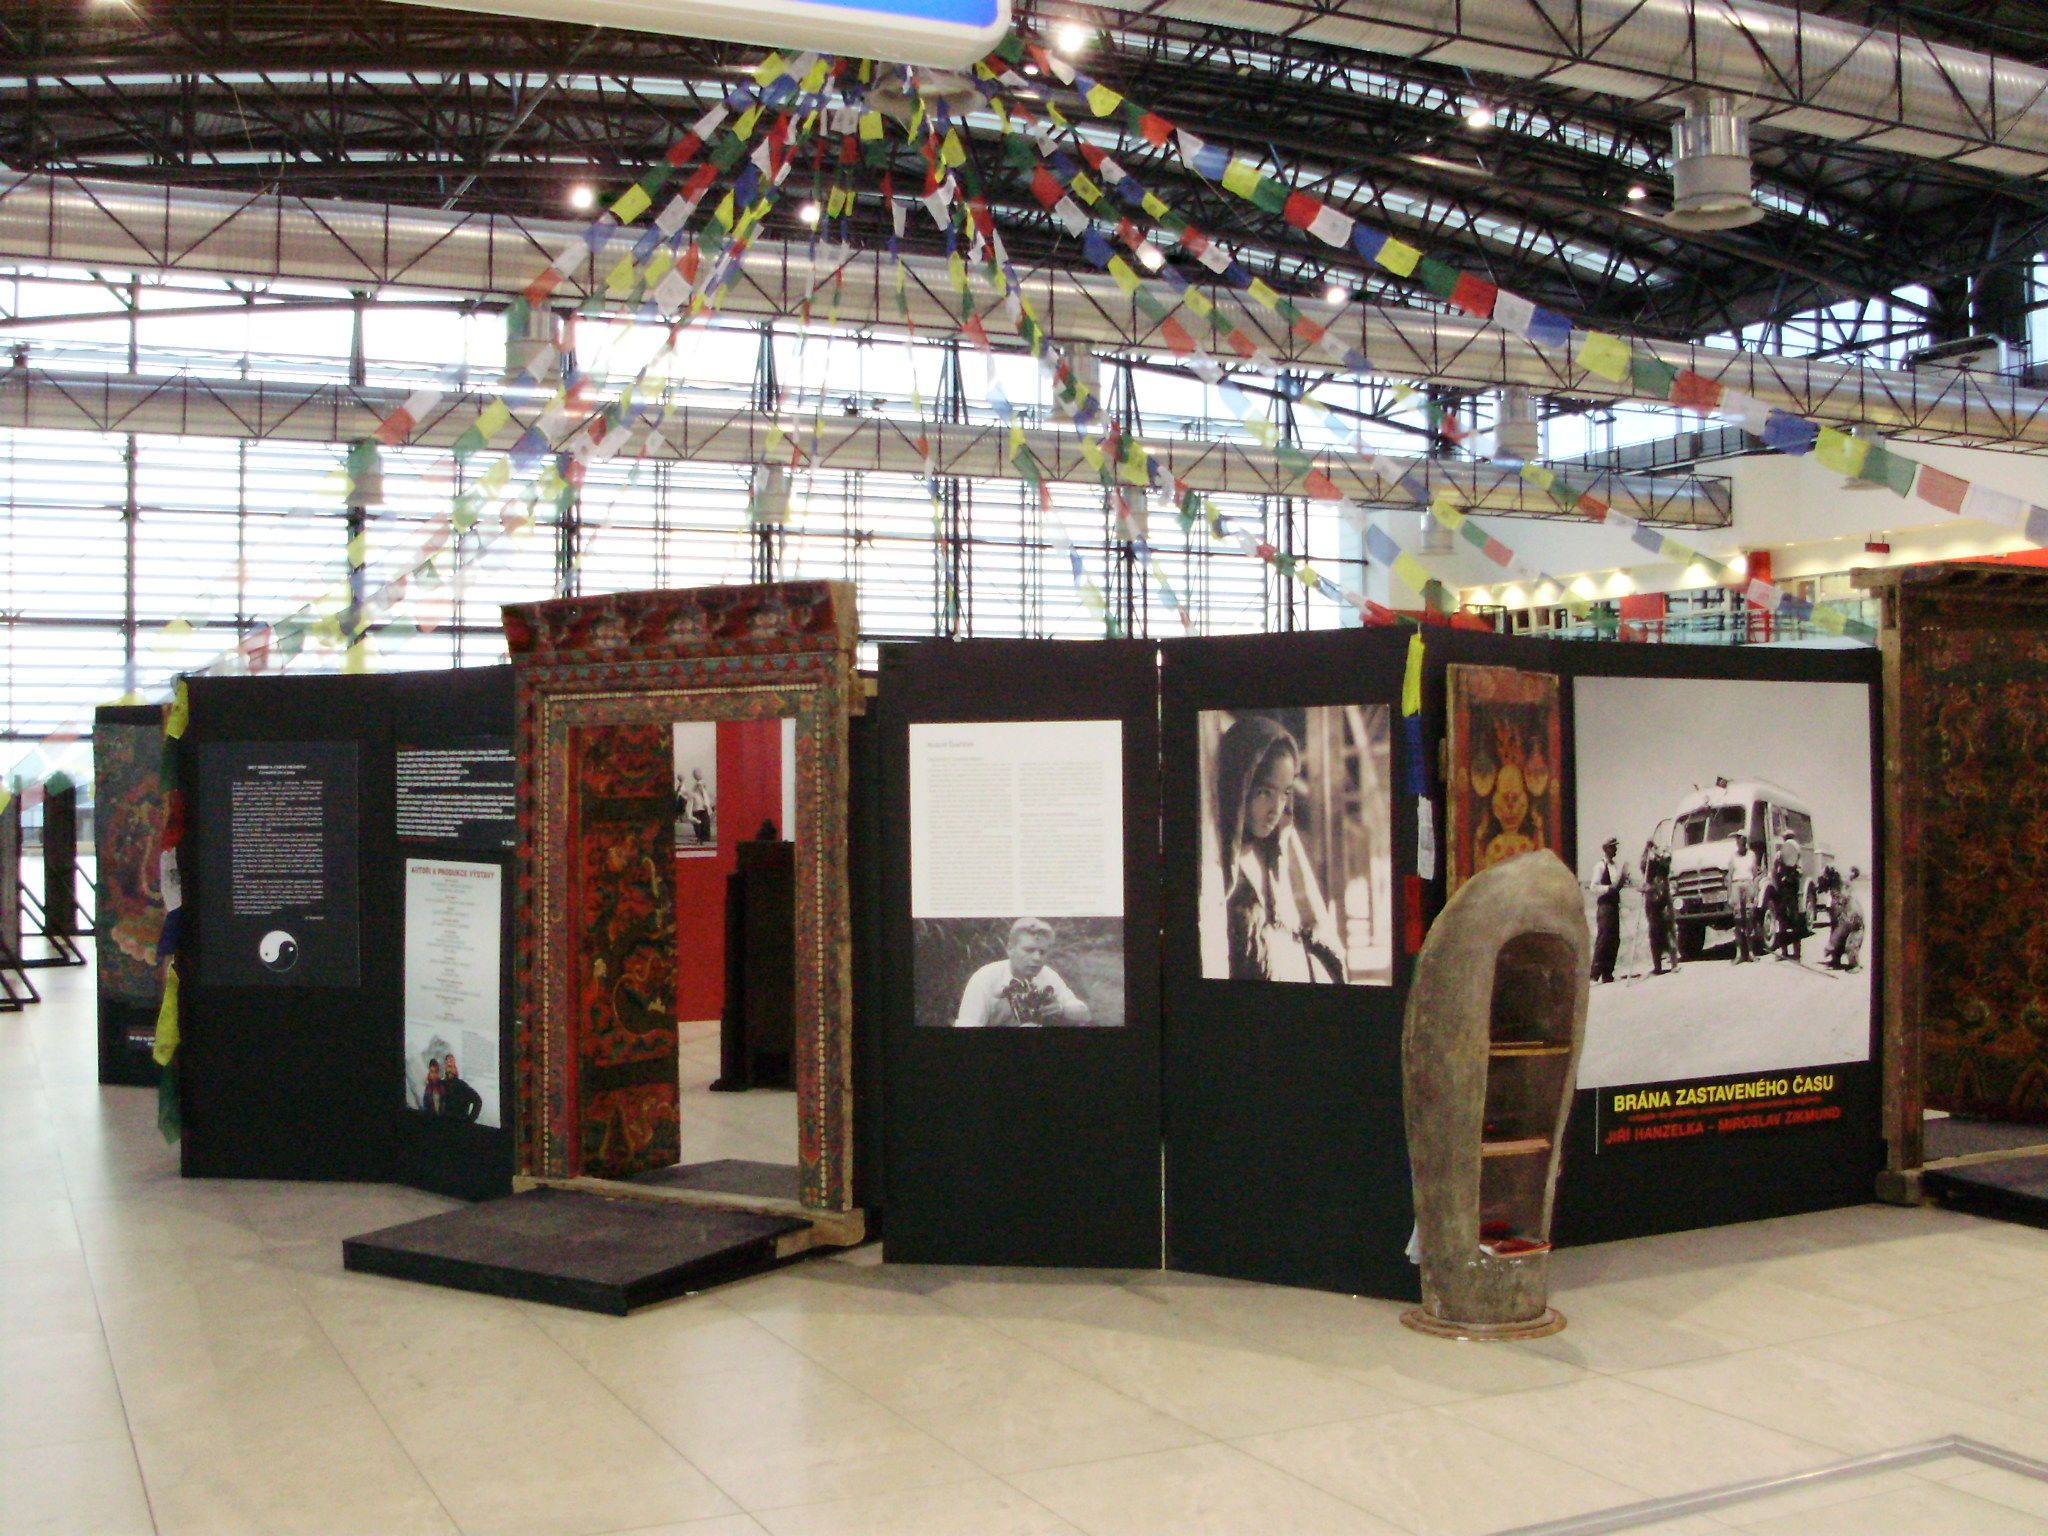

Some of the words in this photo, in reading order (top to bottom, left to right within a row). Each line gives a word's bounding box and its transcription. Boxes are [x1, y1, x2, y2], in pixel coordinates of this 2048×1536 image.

[437, 868, 467, 877] PRODUKCE
[1614, 1090, 1671, 1112] BRÁNA
[1675, 1079, 1788, 1106] ZASTAVENÉHO
[1792, 1074, 1834, 1094] ČASU
[1634, 1122, 1704, 1141] HANZELKA
[1718, 1114, 1781, 1135] MIROSLAV
[1785, 1106, 1842, 1125] ZIKMUND
